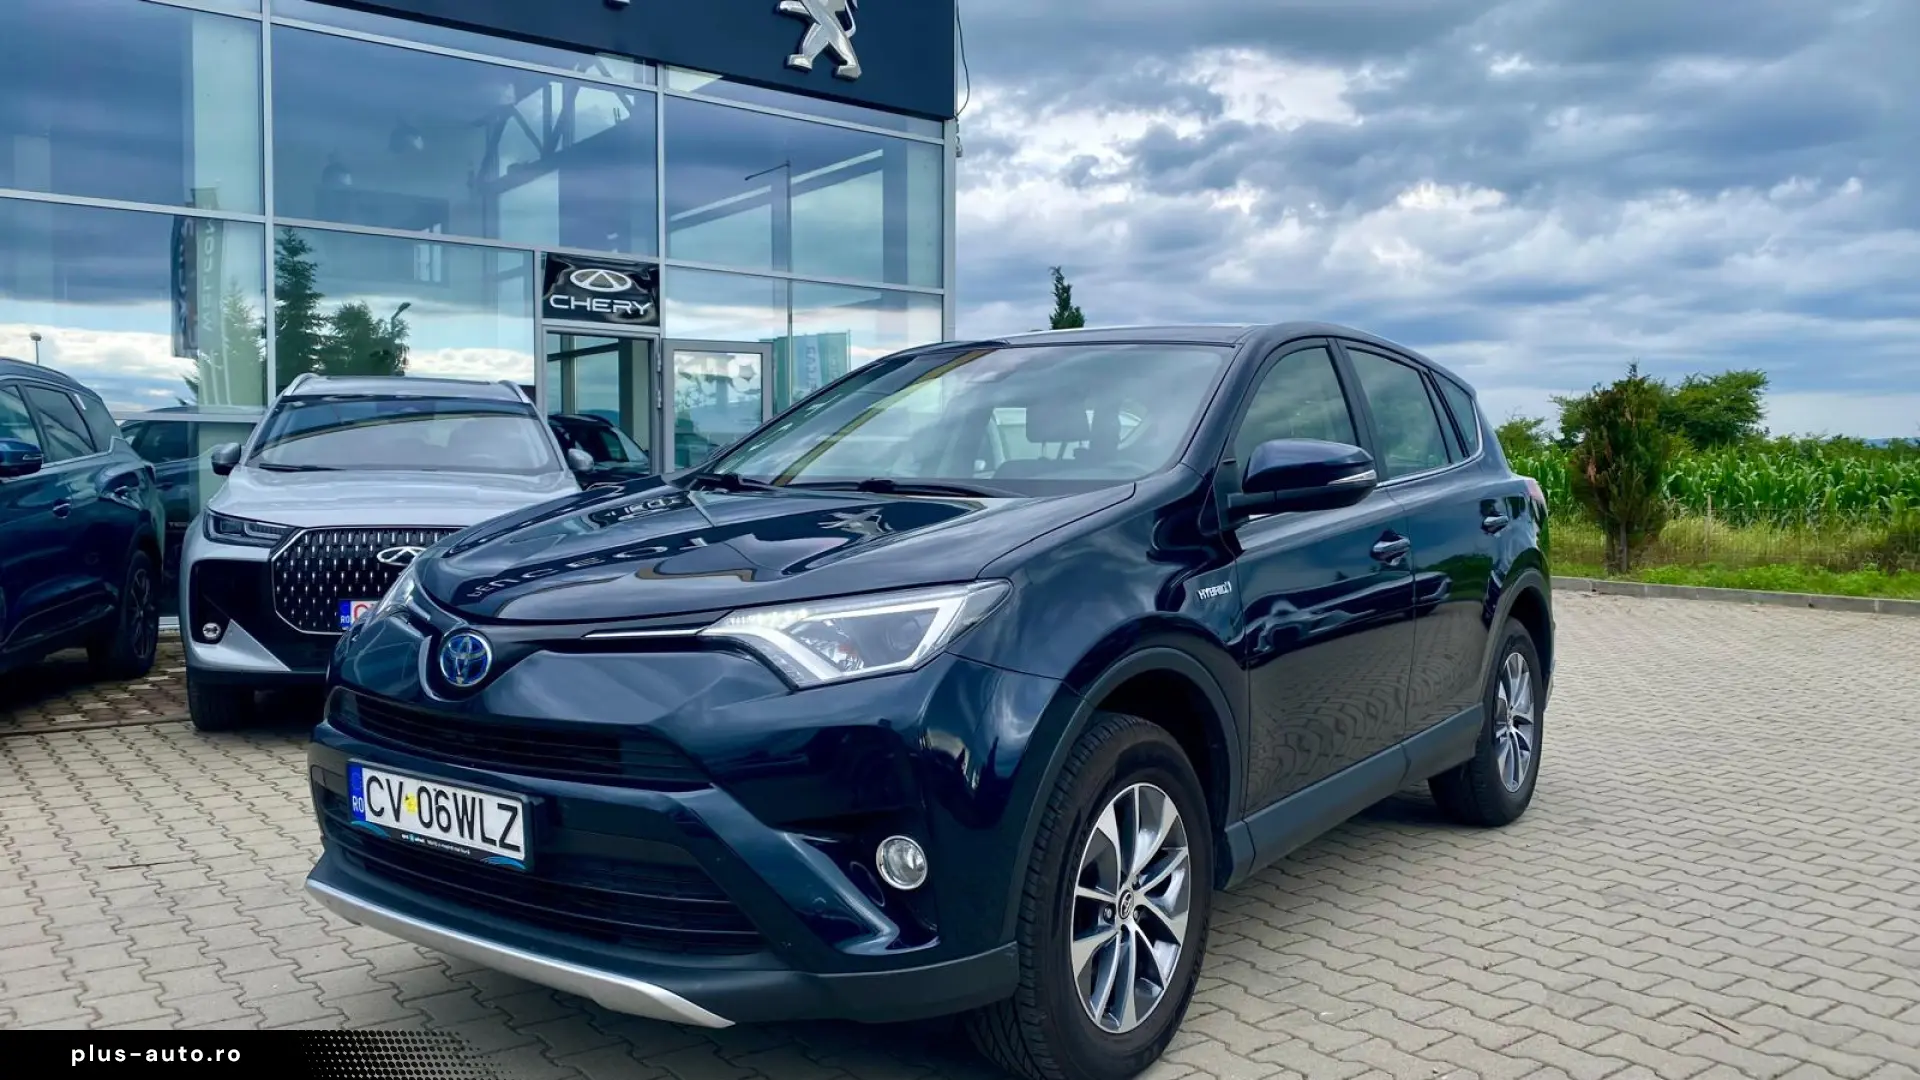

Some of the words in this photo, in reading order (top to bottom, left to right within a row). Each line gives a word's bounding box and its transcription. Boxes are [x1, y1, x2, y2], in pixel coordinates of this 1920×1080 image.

[549, 294, 652, 315] CHERY
[352, 795, 365, 813] RO
[366, 775, 404, 823] CV
